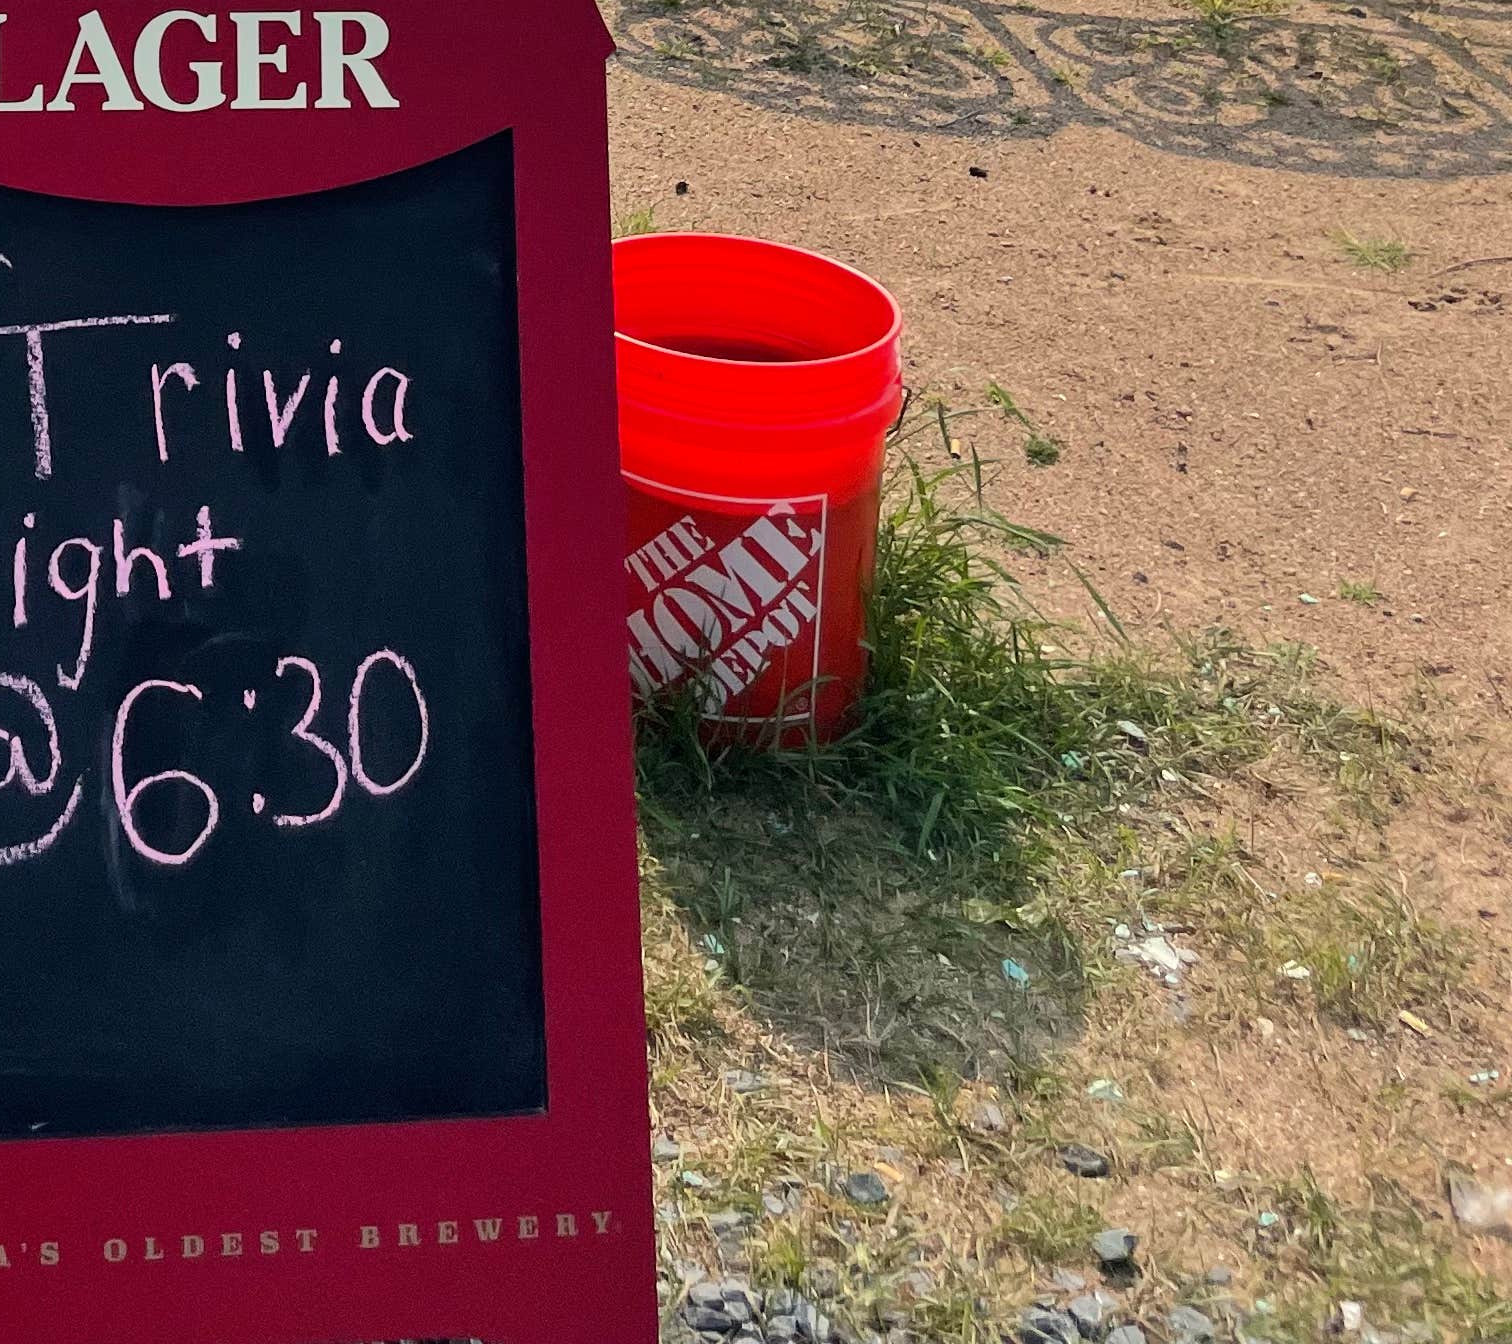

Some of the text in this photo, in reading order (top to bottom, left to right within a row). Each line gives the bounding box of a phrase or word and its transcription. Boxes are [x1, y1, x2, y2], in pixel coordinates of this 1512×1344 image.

[623, 515, 715, 592] THE
[626, 502, 823, 700] HOME
[103, 1228, 318, 1262] OLDEST
[359, 1211, 612, 1248] BREWERY
